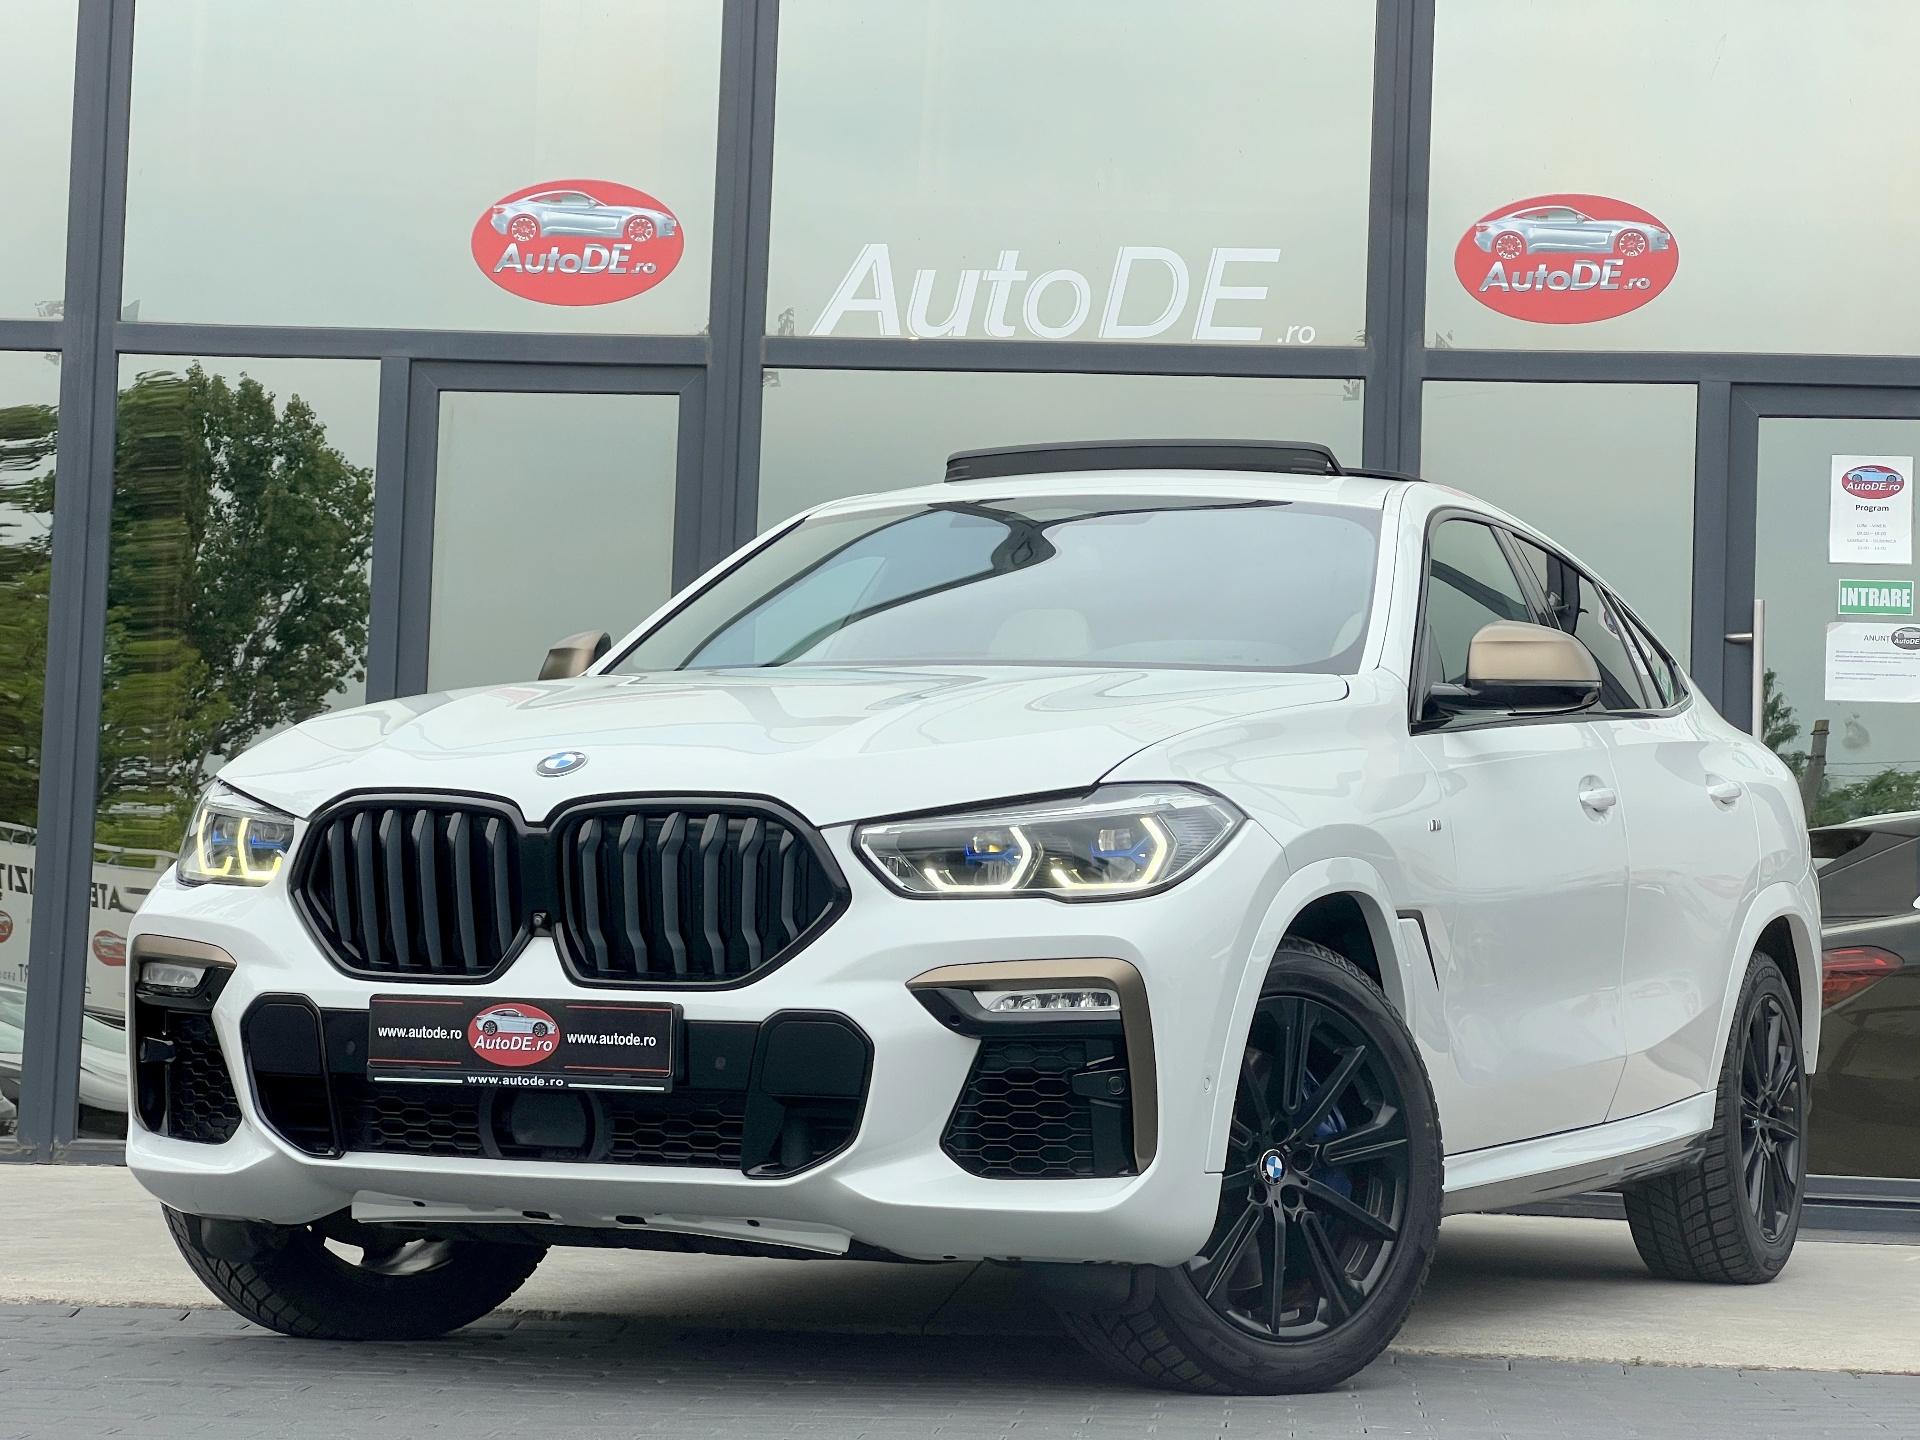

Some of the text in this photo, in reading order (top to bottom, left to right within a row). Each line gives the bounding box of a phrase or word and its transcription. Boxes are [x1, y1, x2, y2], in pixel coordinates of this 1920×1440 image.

[1846, 482, 1901, 491] AutoDE.ro
[1855, 504, 1890, 513] Program
[1841, 587, 1911, 608] INTRARE
[378, 1025, 463, 1040] www.autode.ro
[566, 1031, 657, 1047] www.autode.ro
[474, 1034, 553, 1052] AutoDE.ro
[467, 1074, 564, 1088] www.autode.ro
